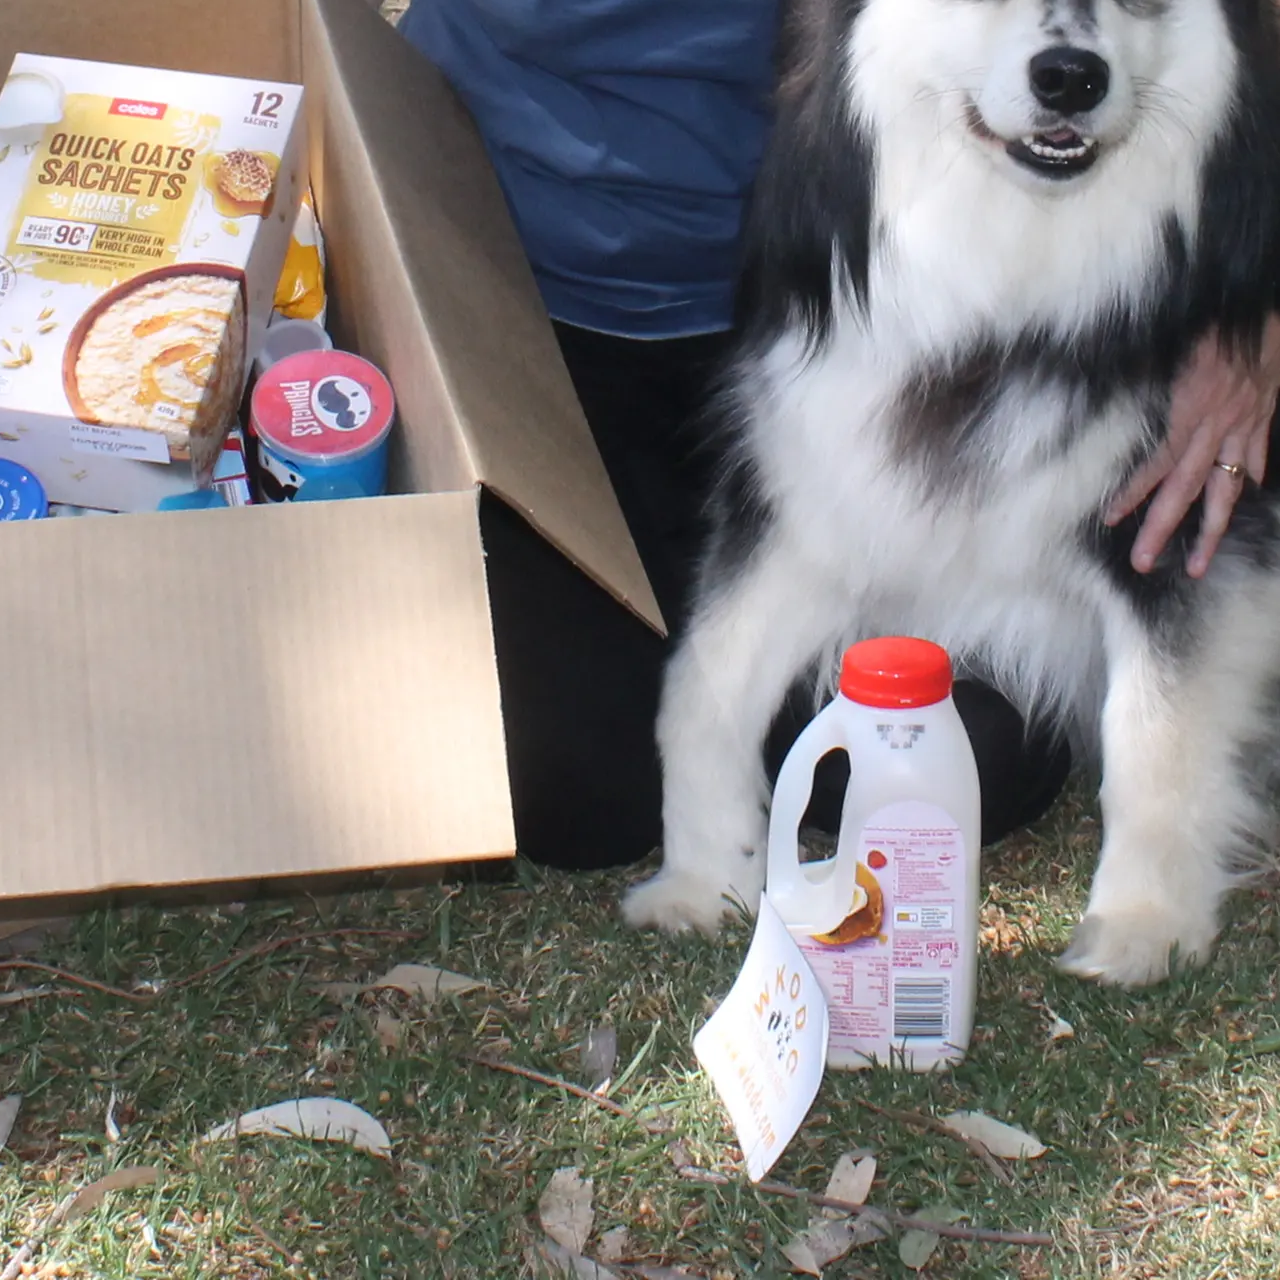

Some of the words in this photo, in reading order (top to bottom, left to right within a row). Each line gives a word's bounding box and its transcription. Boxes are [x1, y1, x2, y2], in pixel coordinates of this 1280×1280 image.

[117, 102, 160, 117] coles
[250, 91, 284, 119] 12
[242, 116, 280, 130] SACHETS
[48, 132, 127, 163] QUICK
[130, 141, 196, 172] OATS
[37, 157, 188, 201] SACHETS
[71, 192, 137, 214] HONEY
[26, 223, 55, 234] READY
[32, 231, 53, 241] JUST
[98, 228, 126, 242] VERY
[126, 232, 151, 246] HIGH
[152, 236, 166, 247] IN
[94, 240, 131, 254] WHOLE
[131, 243, 165, 259] GRAIN
[279, 380, 323, 437] PRINGLES
